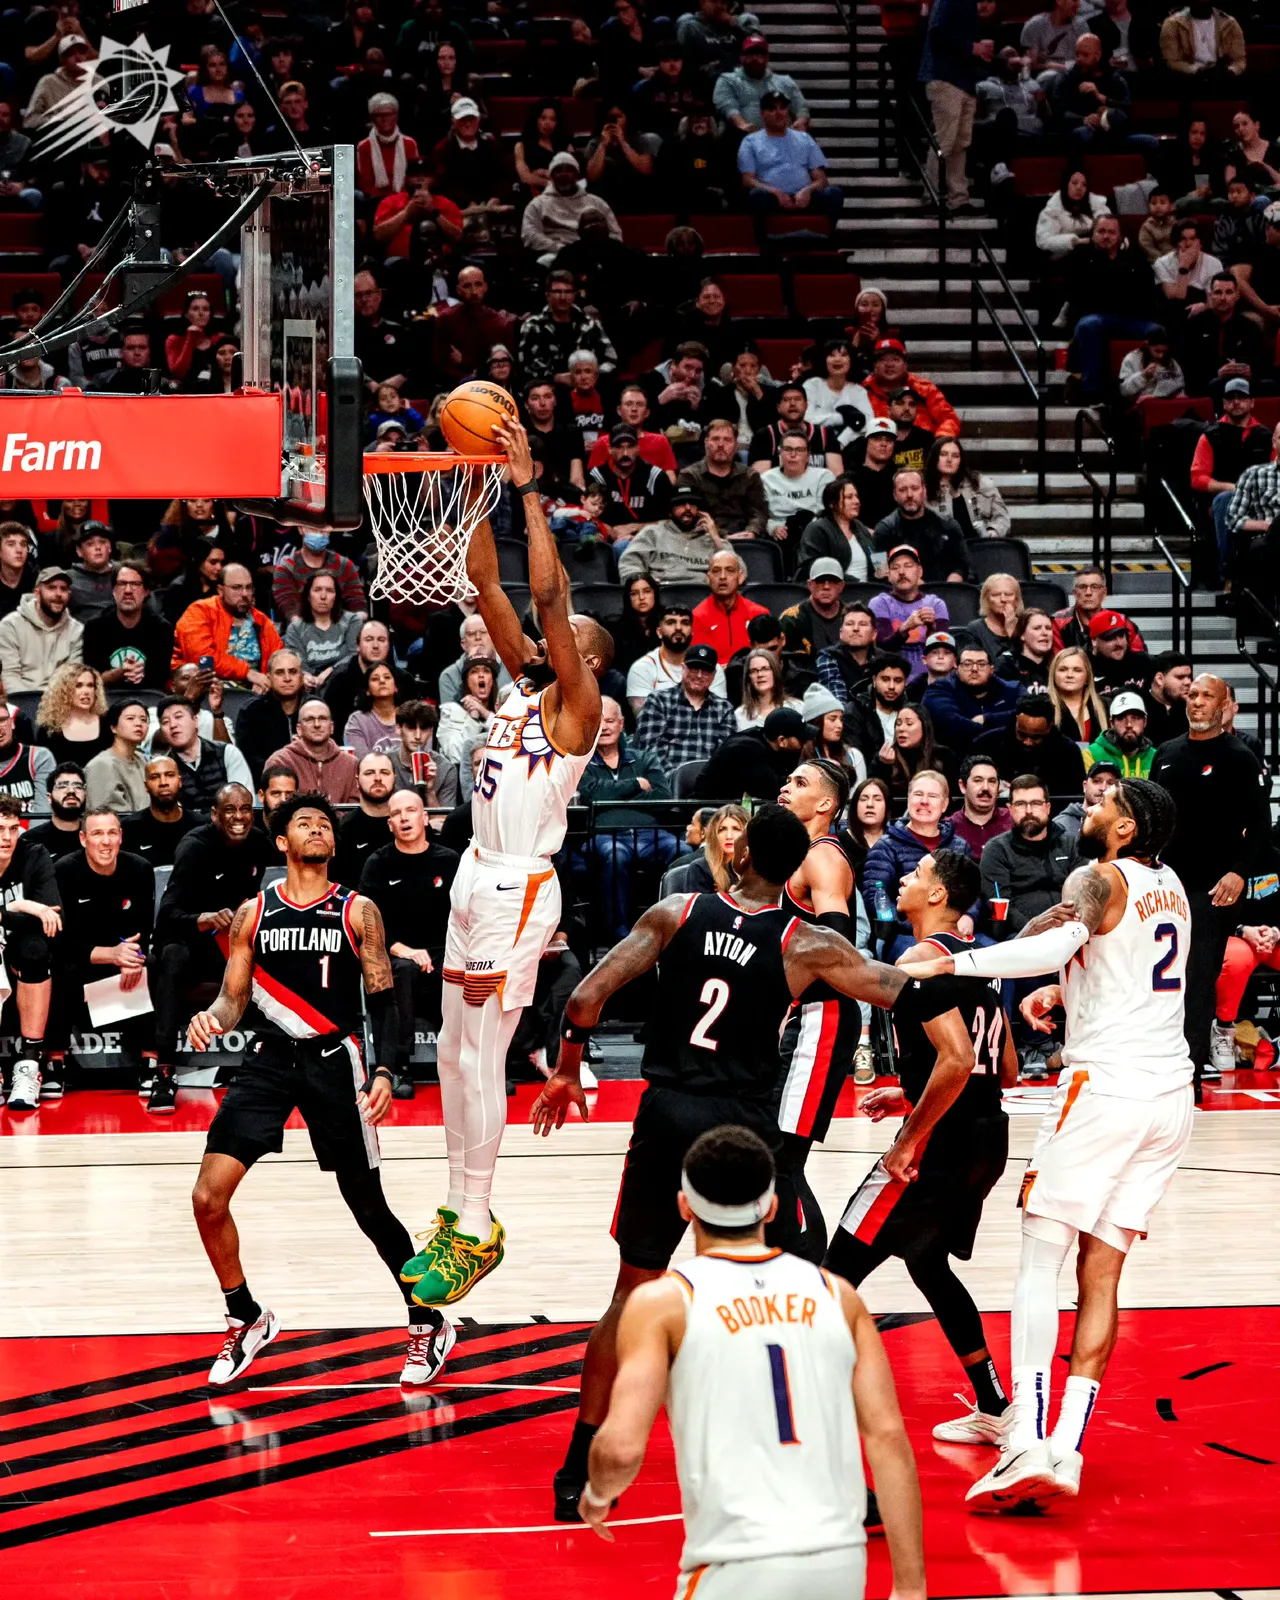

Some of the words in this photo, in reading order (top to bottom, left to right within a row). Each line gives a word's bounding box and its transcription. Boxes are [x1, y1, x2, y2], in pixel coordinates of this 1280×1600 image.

[1, 432, 102, 472] Farm
[1135, 889, 1188, 922] RICHARDS
[259, 927, 342, 954] PORTLAND
[704, 931, 757, 967] AYTON
[1152, 922, 1182, 992] 2
[318, 955, 330, 989] 1
[689, 977, 730, 1051] 2
[970, 1005, 1004, 1075] 24
[716, 1293, 817, 1335] BOOKER
[765, 1342, 802, 1446] 1
